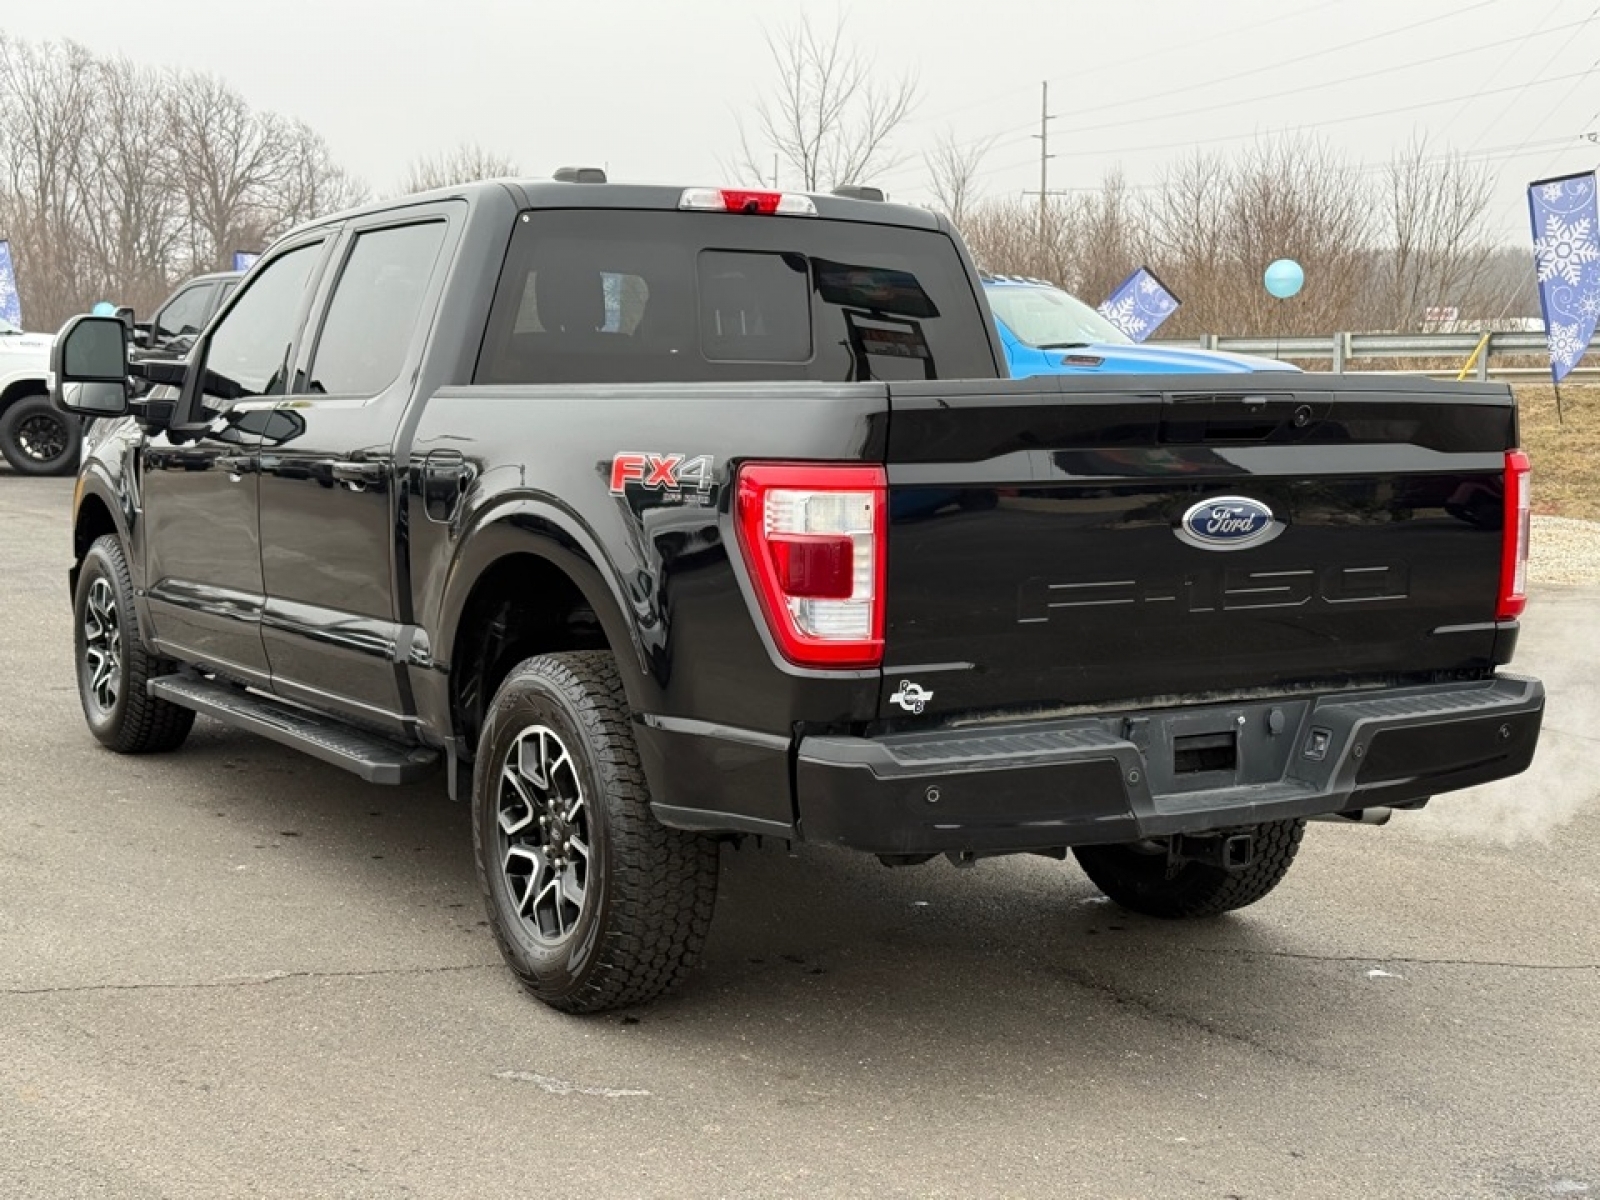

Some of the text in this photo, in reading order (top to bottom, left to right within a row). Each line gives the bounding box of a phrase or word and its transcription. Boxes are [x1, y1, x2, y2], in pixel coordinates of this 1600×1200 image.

[609, 452, 714, 496] FX4
[1206, 505, 1256, 533] Ford
[1017, 558, 1411, 622] F-150
